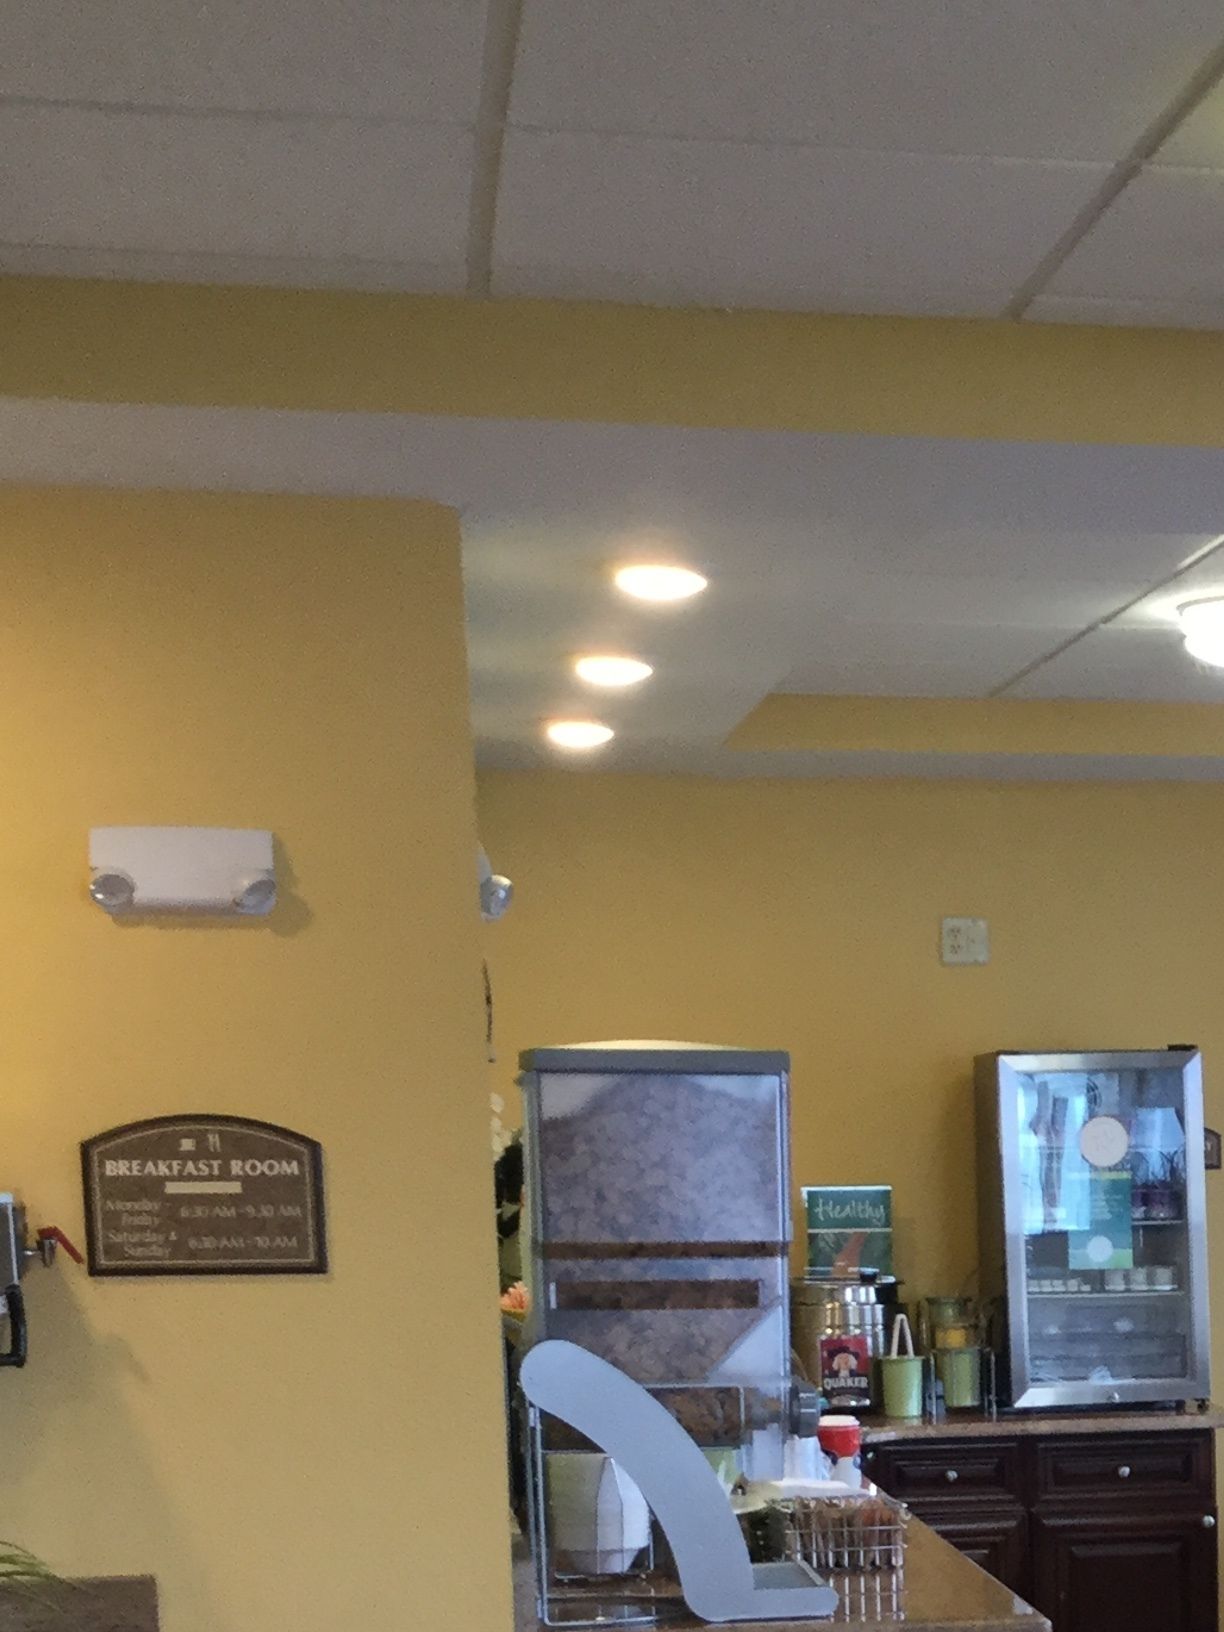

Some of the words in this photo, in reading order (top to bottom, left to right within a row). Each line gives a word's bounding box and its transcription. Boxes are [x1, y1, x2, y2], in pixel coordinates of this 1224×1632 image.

[105, 1159, 222, 1176] BREAKFAST
[230, 1159, 300, 1176] ROOM
[814, 1199, 886, 1226] Healthy
[823, 1376, 868, 1391] QUAKER
